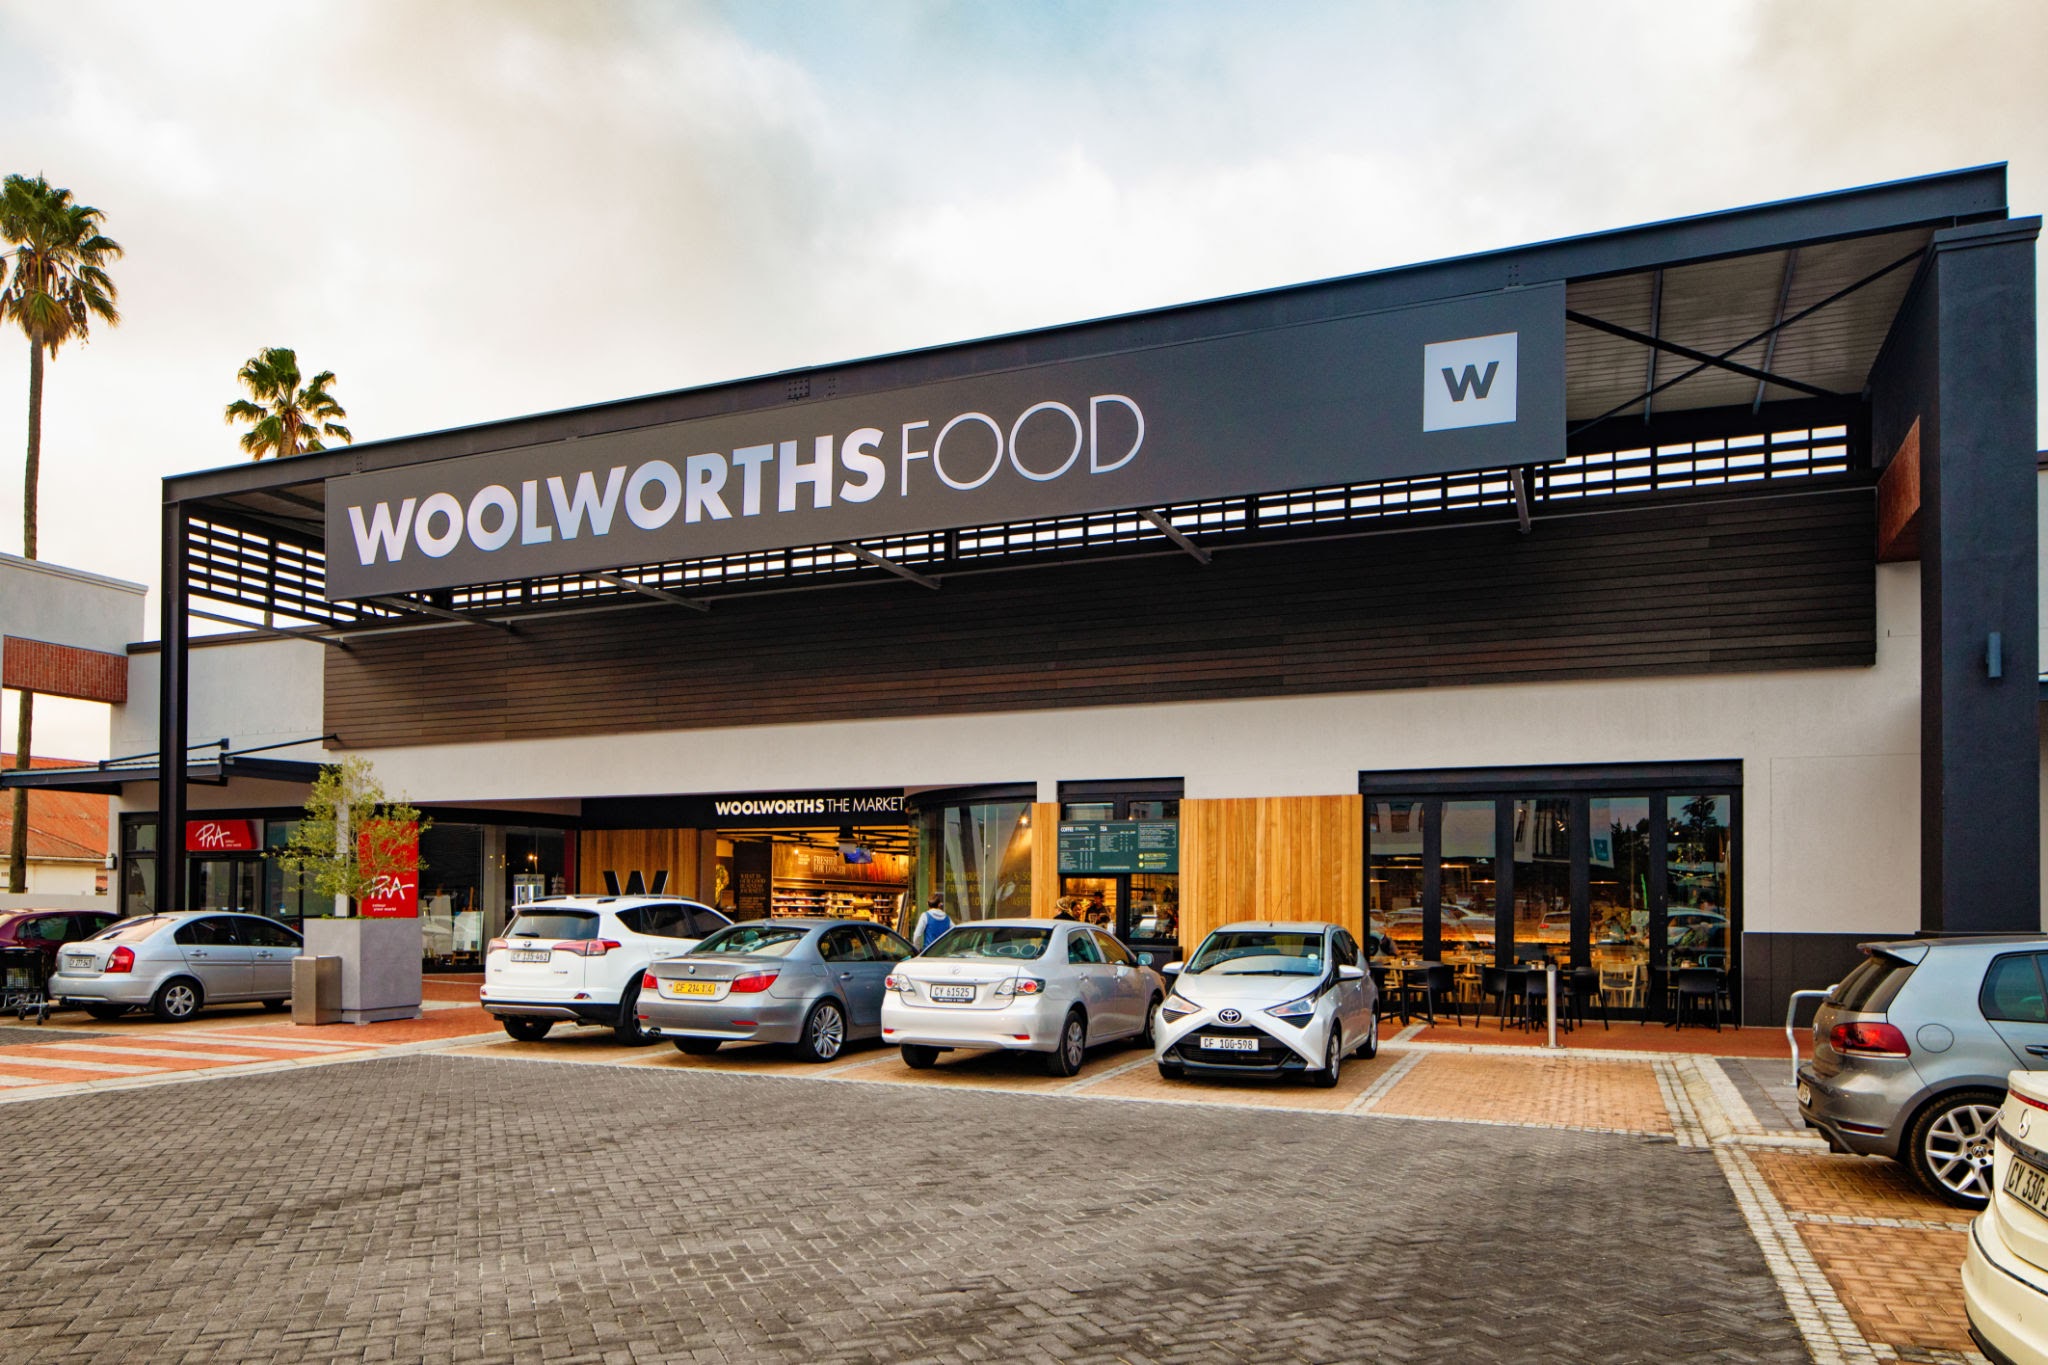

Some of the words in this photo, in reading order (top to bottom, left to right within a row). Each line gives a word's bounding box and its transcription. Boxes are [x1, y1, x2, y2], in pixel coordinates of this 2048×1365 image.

[1441, 361, 1499, 403] W
[348, 427, 885, 565] WOOLWORTHS
[900, 394, 1145, 496] FOOD
[715, 798, 825, 816] WOOLWORTHS
[826, 797, 850, 813] THE
[852, 796, 905, 812] MARKET
[1204, 1038, 1214, 1048] CF
[2008, 1161, 2026, 1192] CY
